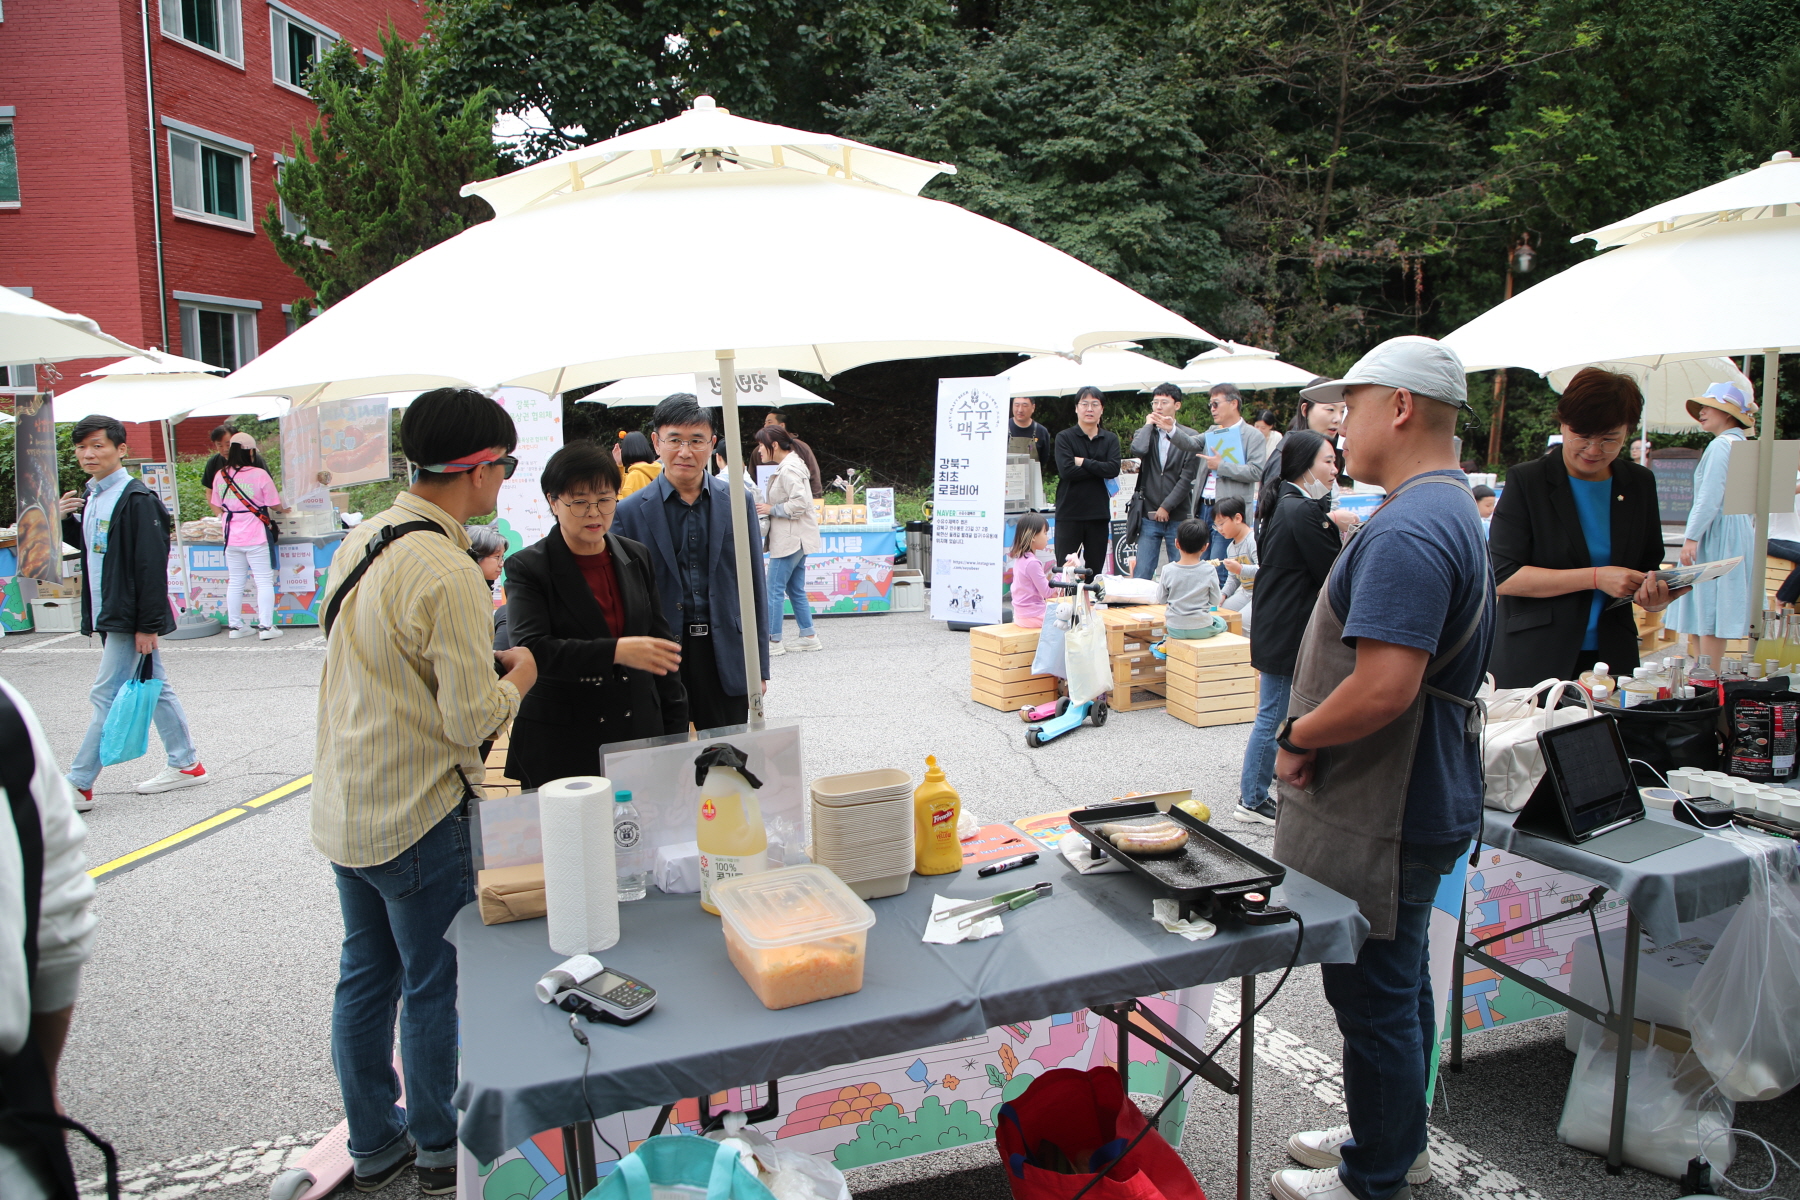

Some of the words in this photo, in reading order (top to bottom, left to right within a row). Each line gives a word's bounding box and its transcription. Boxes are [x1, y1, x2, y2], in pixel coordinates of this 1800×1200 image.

[516, 400, 536, 410] 강북구
[957, 400, 992, 420] 수유
[532, 411, 552, 421] 협의체
[957, 421, 992, 440] 맥주
[940, 458, 970, 470] 강북구
[938, 471, 958, 482] 최초
[938, 484, 978, 495] 로컬비어
[715, 862, 737, 872] 100%
